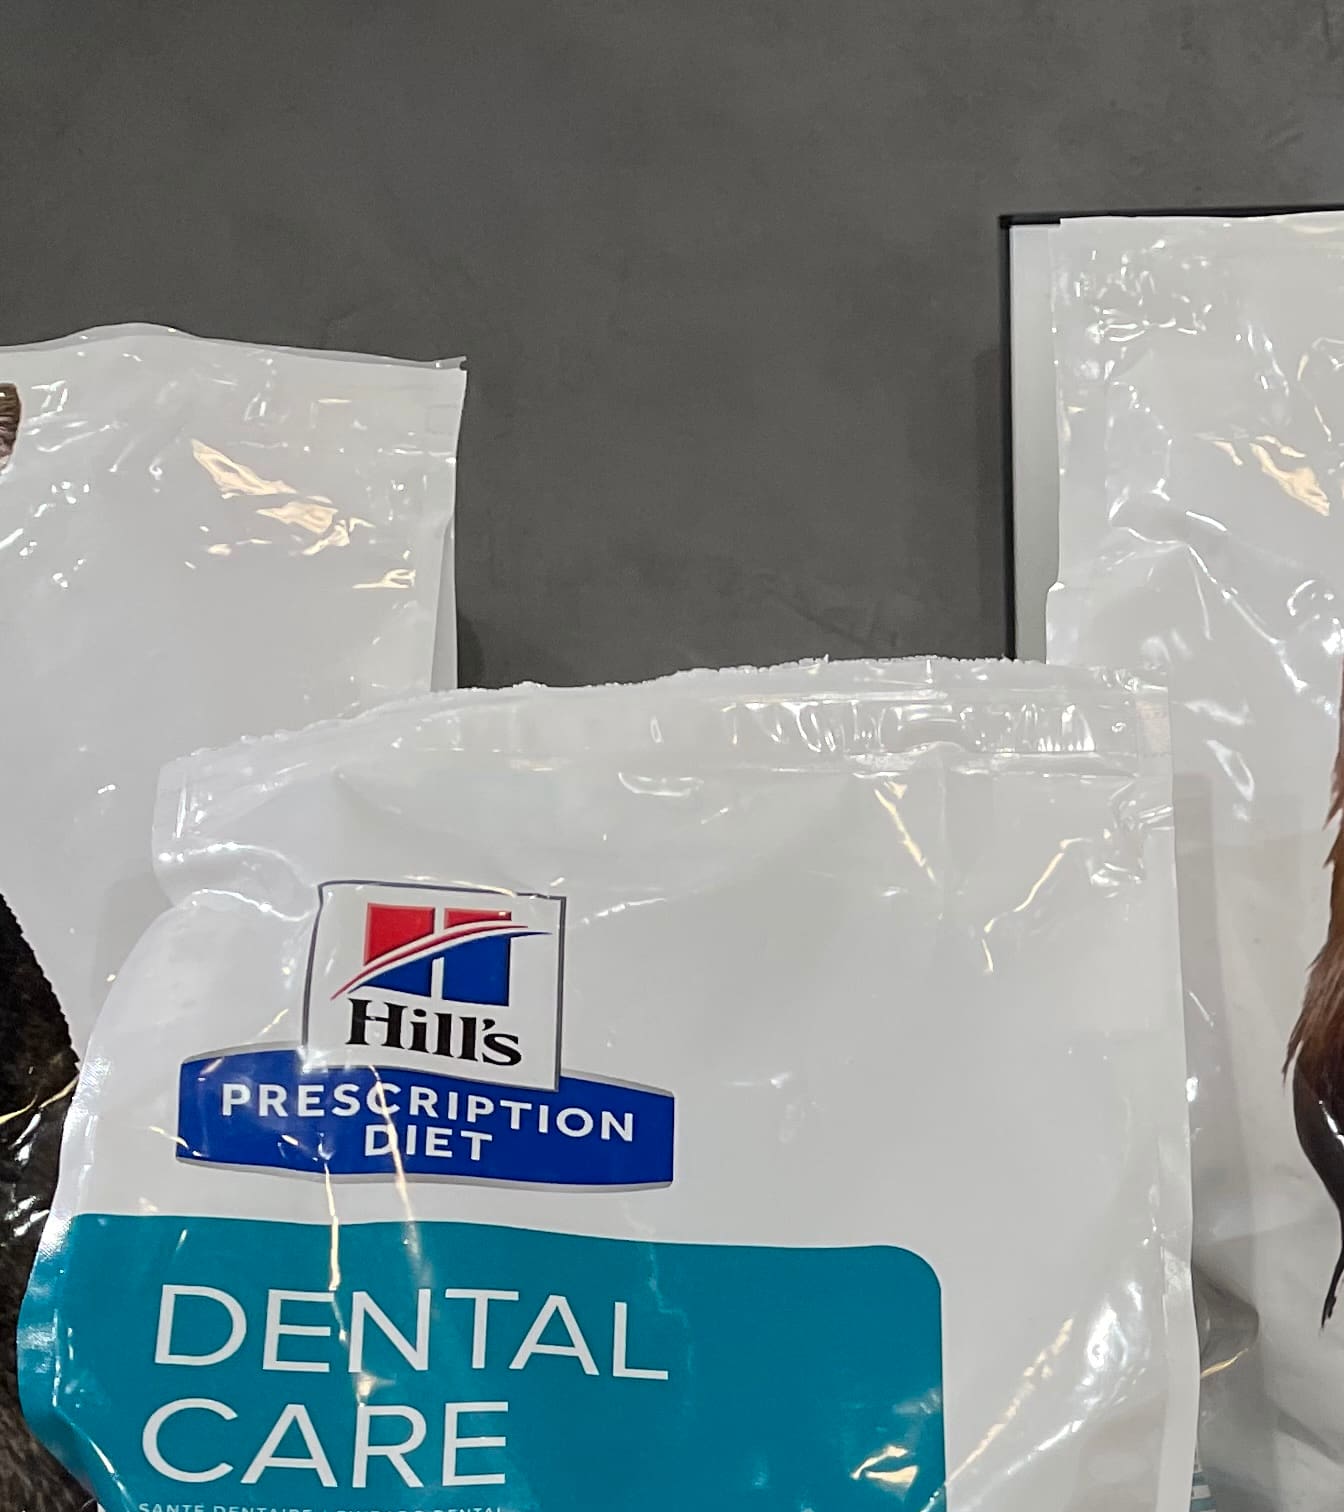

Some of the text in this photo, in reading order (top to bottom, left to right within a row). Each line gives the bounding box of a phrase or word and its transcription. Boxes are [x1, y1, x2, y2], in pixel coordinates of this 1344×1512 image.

[344, 998, 522, 1067] Hill's
[222, 1083, 634, 1143] PRESCRIPTION
[364, 1124, 493, 1161] DIET
[152, 1284, 669, 1382] DENTAL
[141, 1397, 510, 1490] CARE
